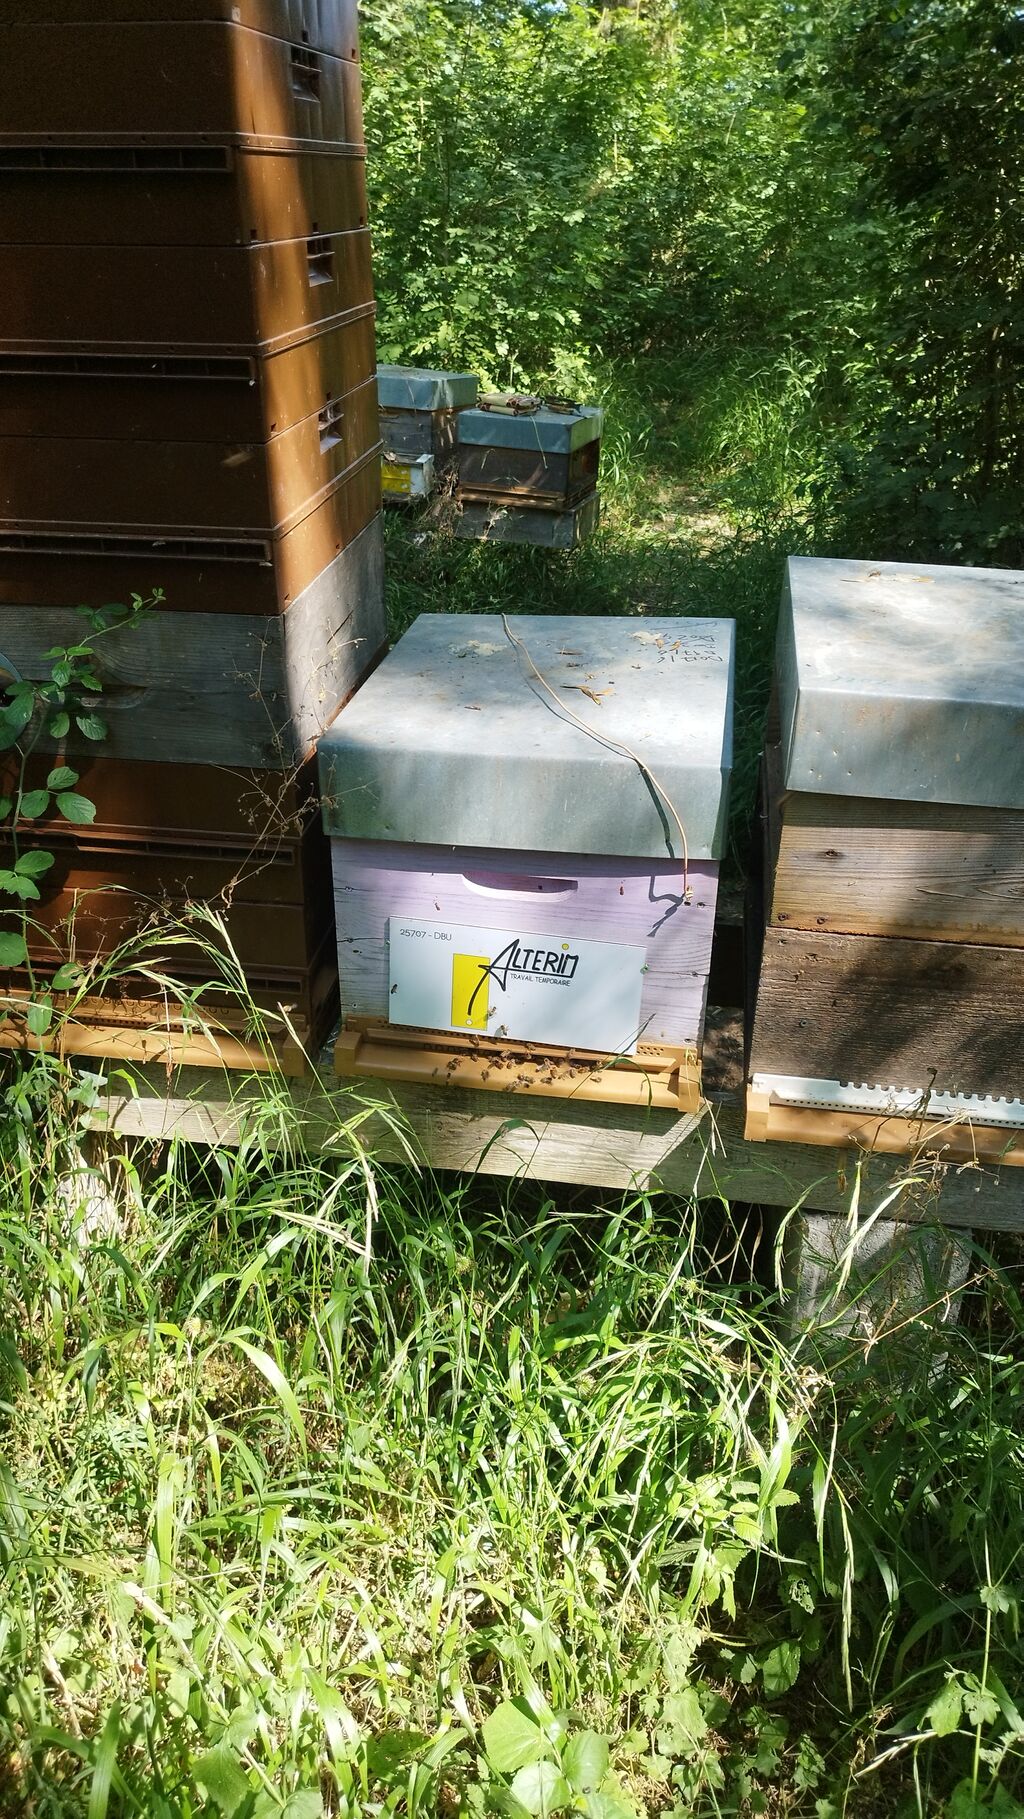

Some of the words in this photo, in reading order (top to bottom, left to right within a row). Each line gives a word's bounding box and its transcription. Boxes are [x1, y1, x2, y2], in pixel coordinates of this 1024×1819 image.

[400, 929, 427, 939] 25707
[434, 931, 453, 942] DBU
[510, 973, 534, 983] TRAVAIL
[535, 976, 571, 987] TEMPORAIRE
